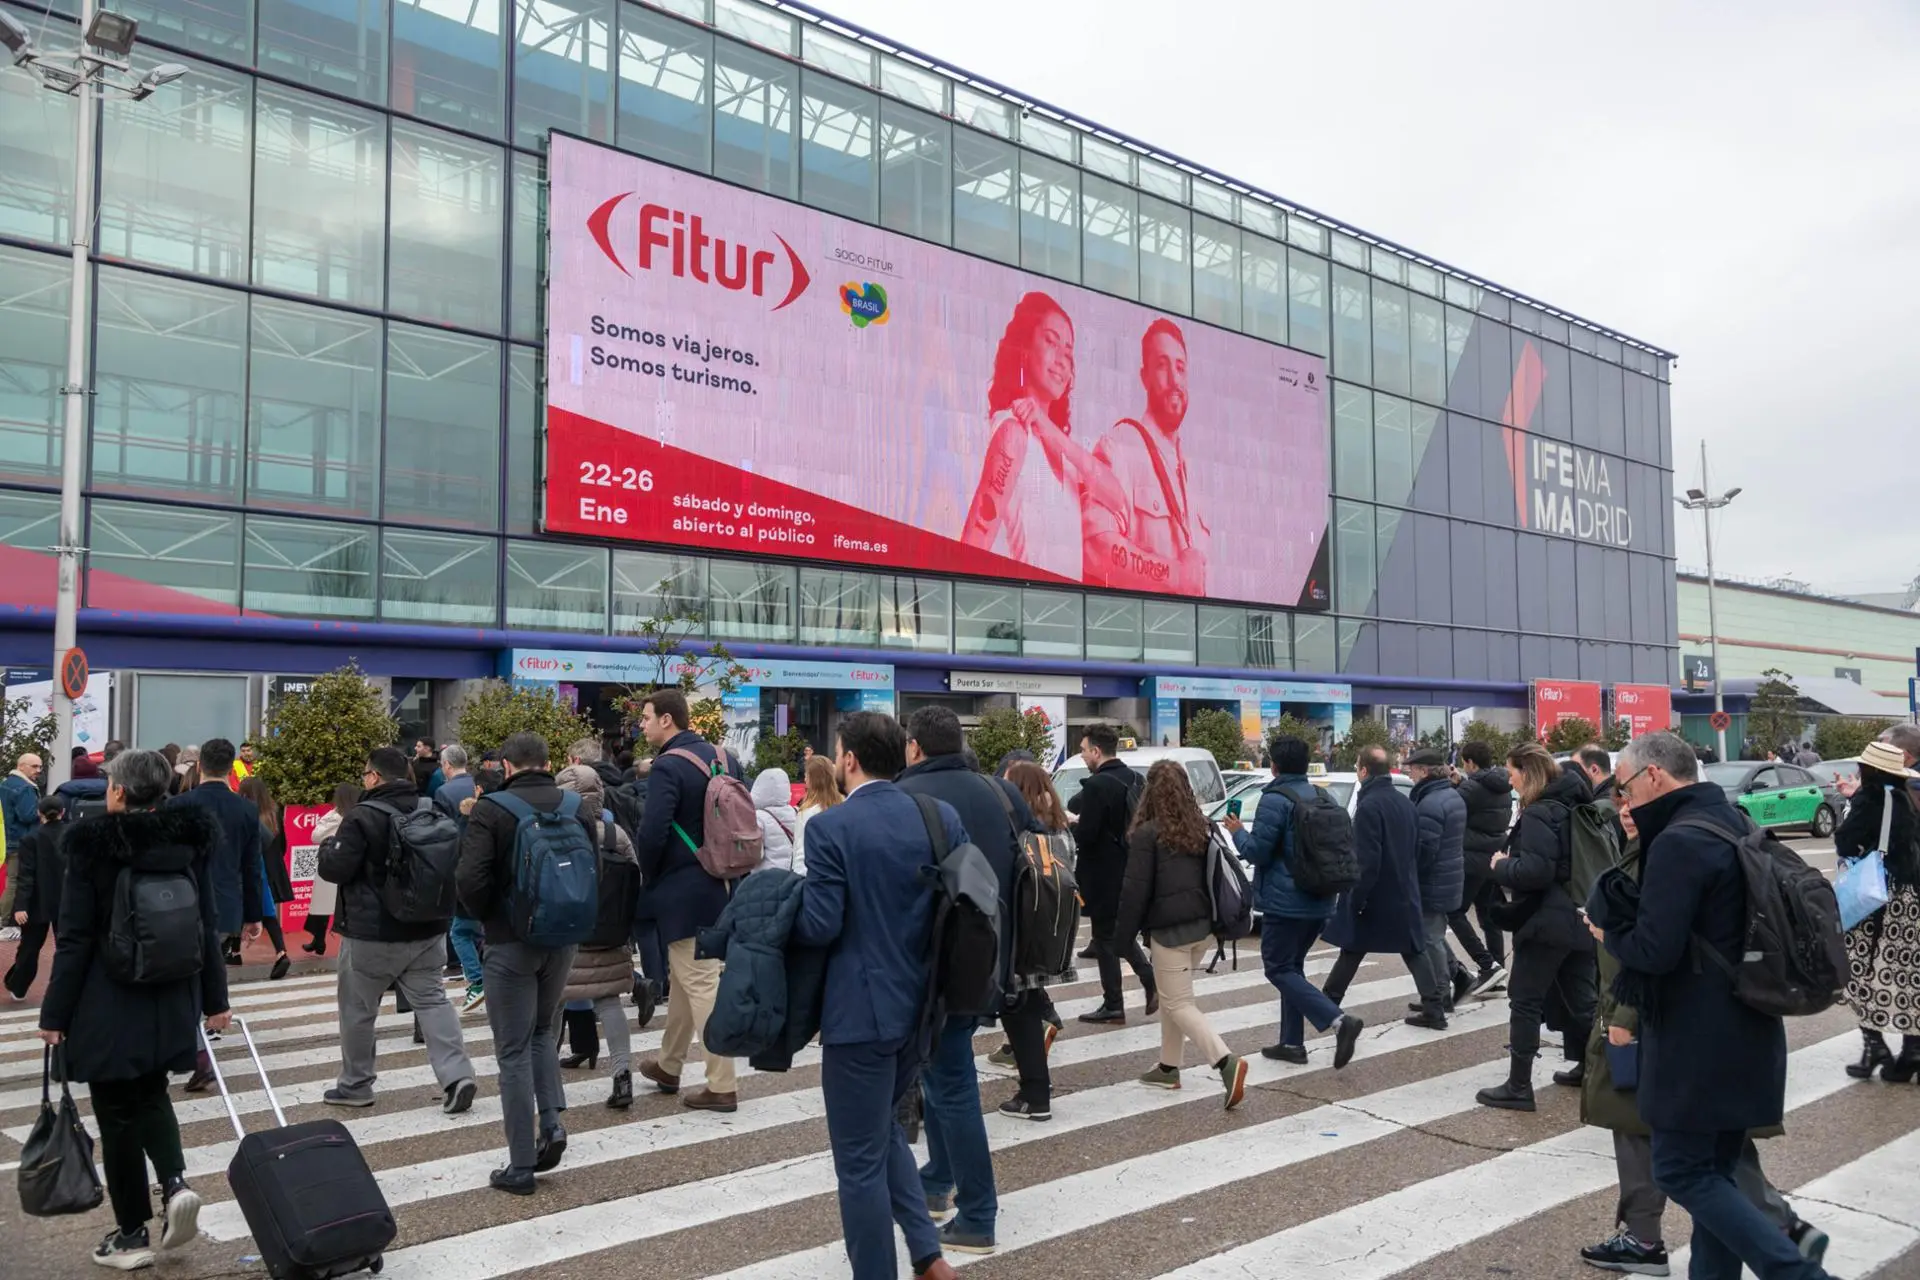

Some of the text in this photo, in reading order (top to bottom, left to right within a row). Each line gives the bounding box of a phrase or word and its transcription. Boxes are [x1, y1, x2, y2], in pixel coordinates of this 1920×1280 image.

[639, 203, 775, 297] Fitur
[835, 248, 893, 272] SOCIO FITUR
[852, 298, 879, 313] BRASIL
[591, 315, 759, 367] Somos viajeros.
[591, 346, 757, 395] Somos turismo.
[580, 461, 654, 492] 22-26
[1533, 439, 1611, 497] IFEMA
[580, 498, 628, 525] Ene
[673, 493, 816, 526] sábado y domingo,
[1534, 488, 1632, 546] MADRID
[673, 517, 815, 545] abierto al público
[834, 535, 888, 553] ifema.es
[1111, 544, 1127, 569] GO
[527, 657, 552, 670] Fitur
[957, 678, 979, 688] Puerta
[981, 679, 994, 688] Sur
[303, 813, 321, 828] Fit
